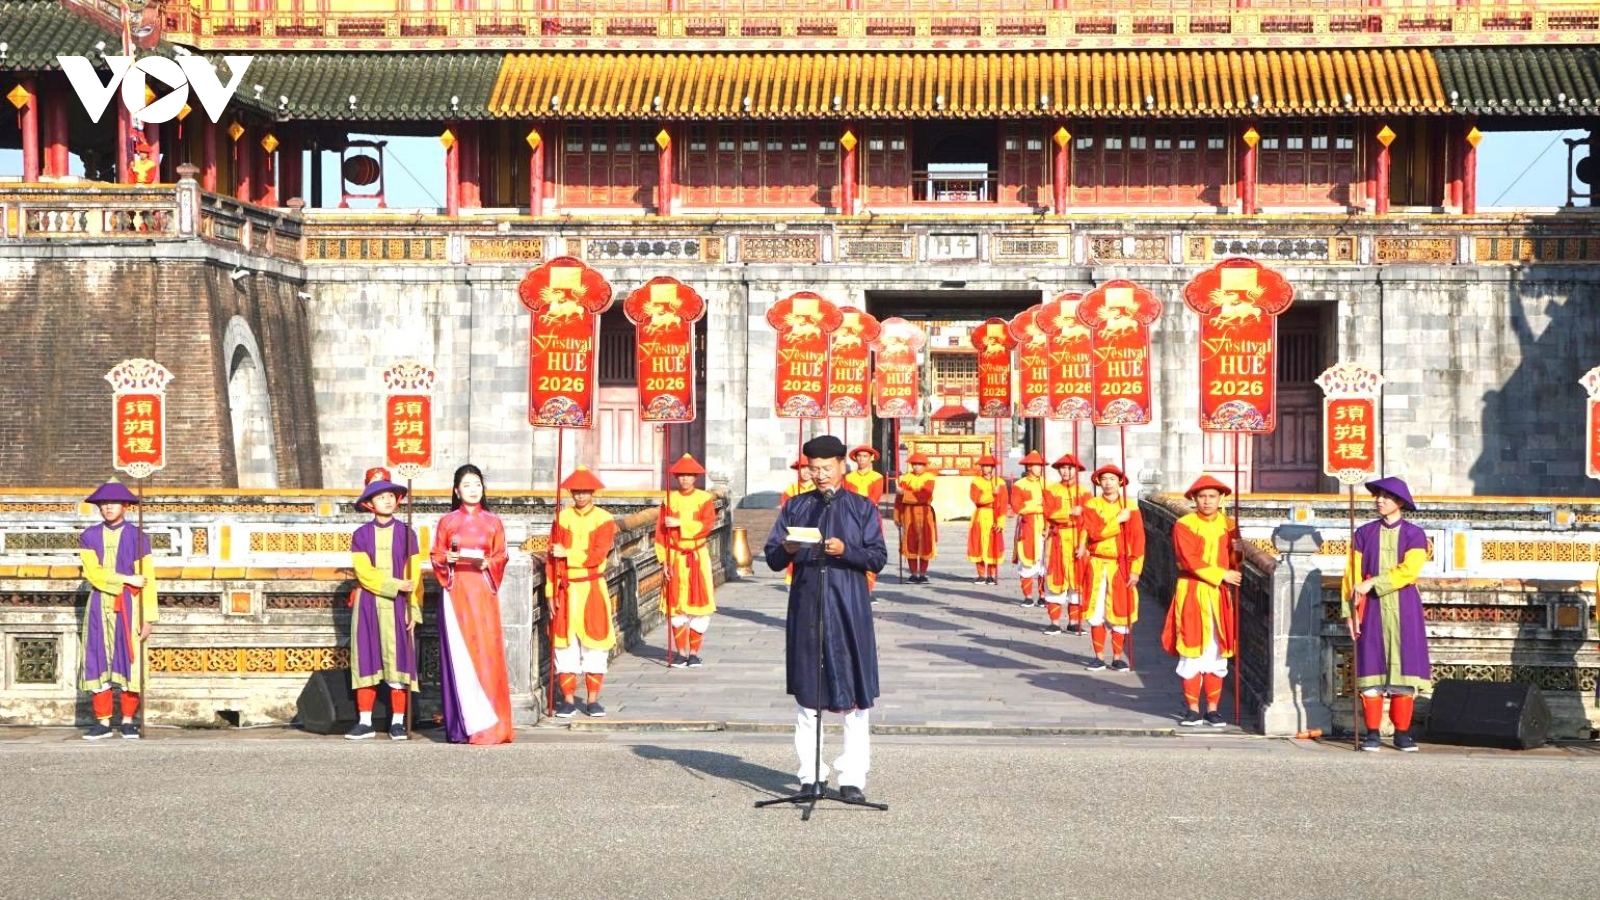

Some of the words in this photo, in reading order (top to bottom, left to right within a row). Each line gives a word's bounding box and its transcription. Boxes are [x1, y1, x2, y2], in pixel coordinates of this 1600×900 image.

[532, 324, 592, 356] Festival
[639, 333, 689, 362] Festival
[1202, 327, 1272, 361] Festival
[777, 342, 827, 366] Festival
[1049, 346, 1090, 369] Festiv
[1093, 339, 1147, 367] Festival
[539, 376, 585, 392] 2026
[646, 377, 685, 390] 2026
[782, 380, 821, 392] 2026
[829, 383, 863, 394] 2026
[882, 387, 911, 396] 2026
[1101, 382, 1142, 395] 2026
[1209, 380, 1264, 396] 2026
[982, 388, 1007, 397] 2026
